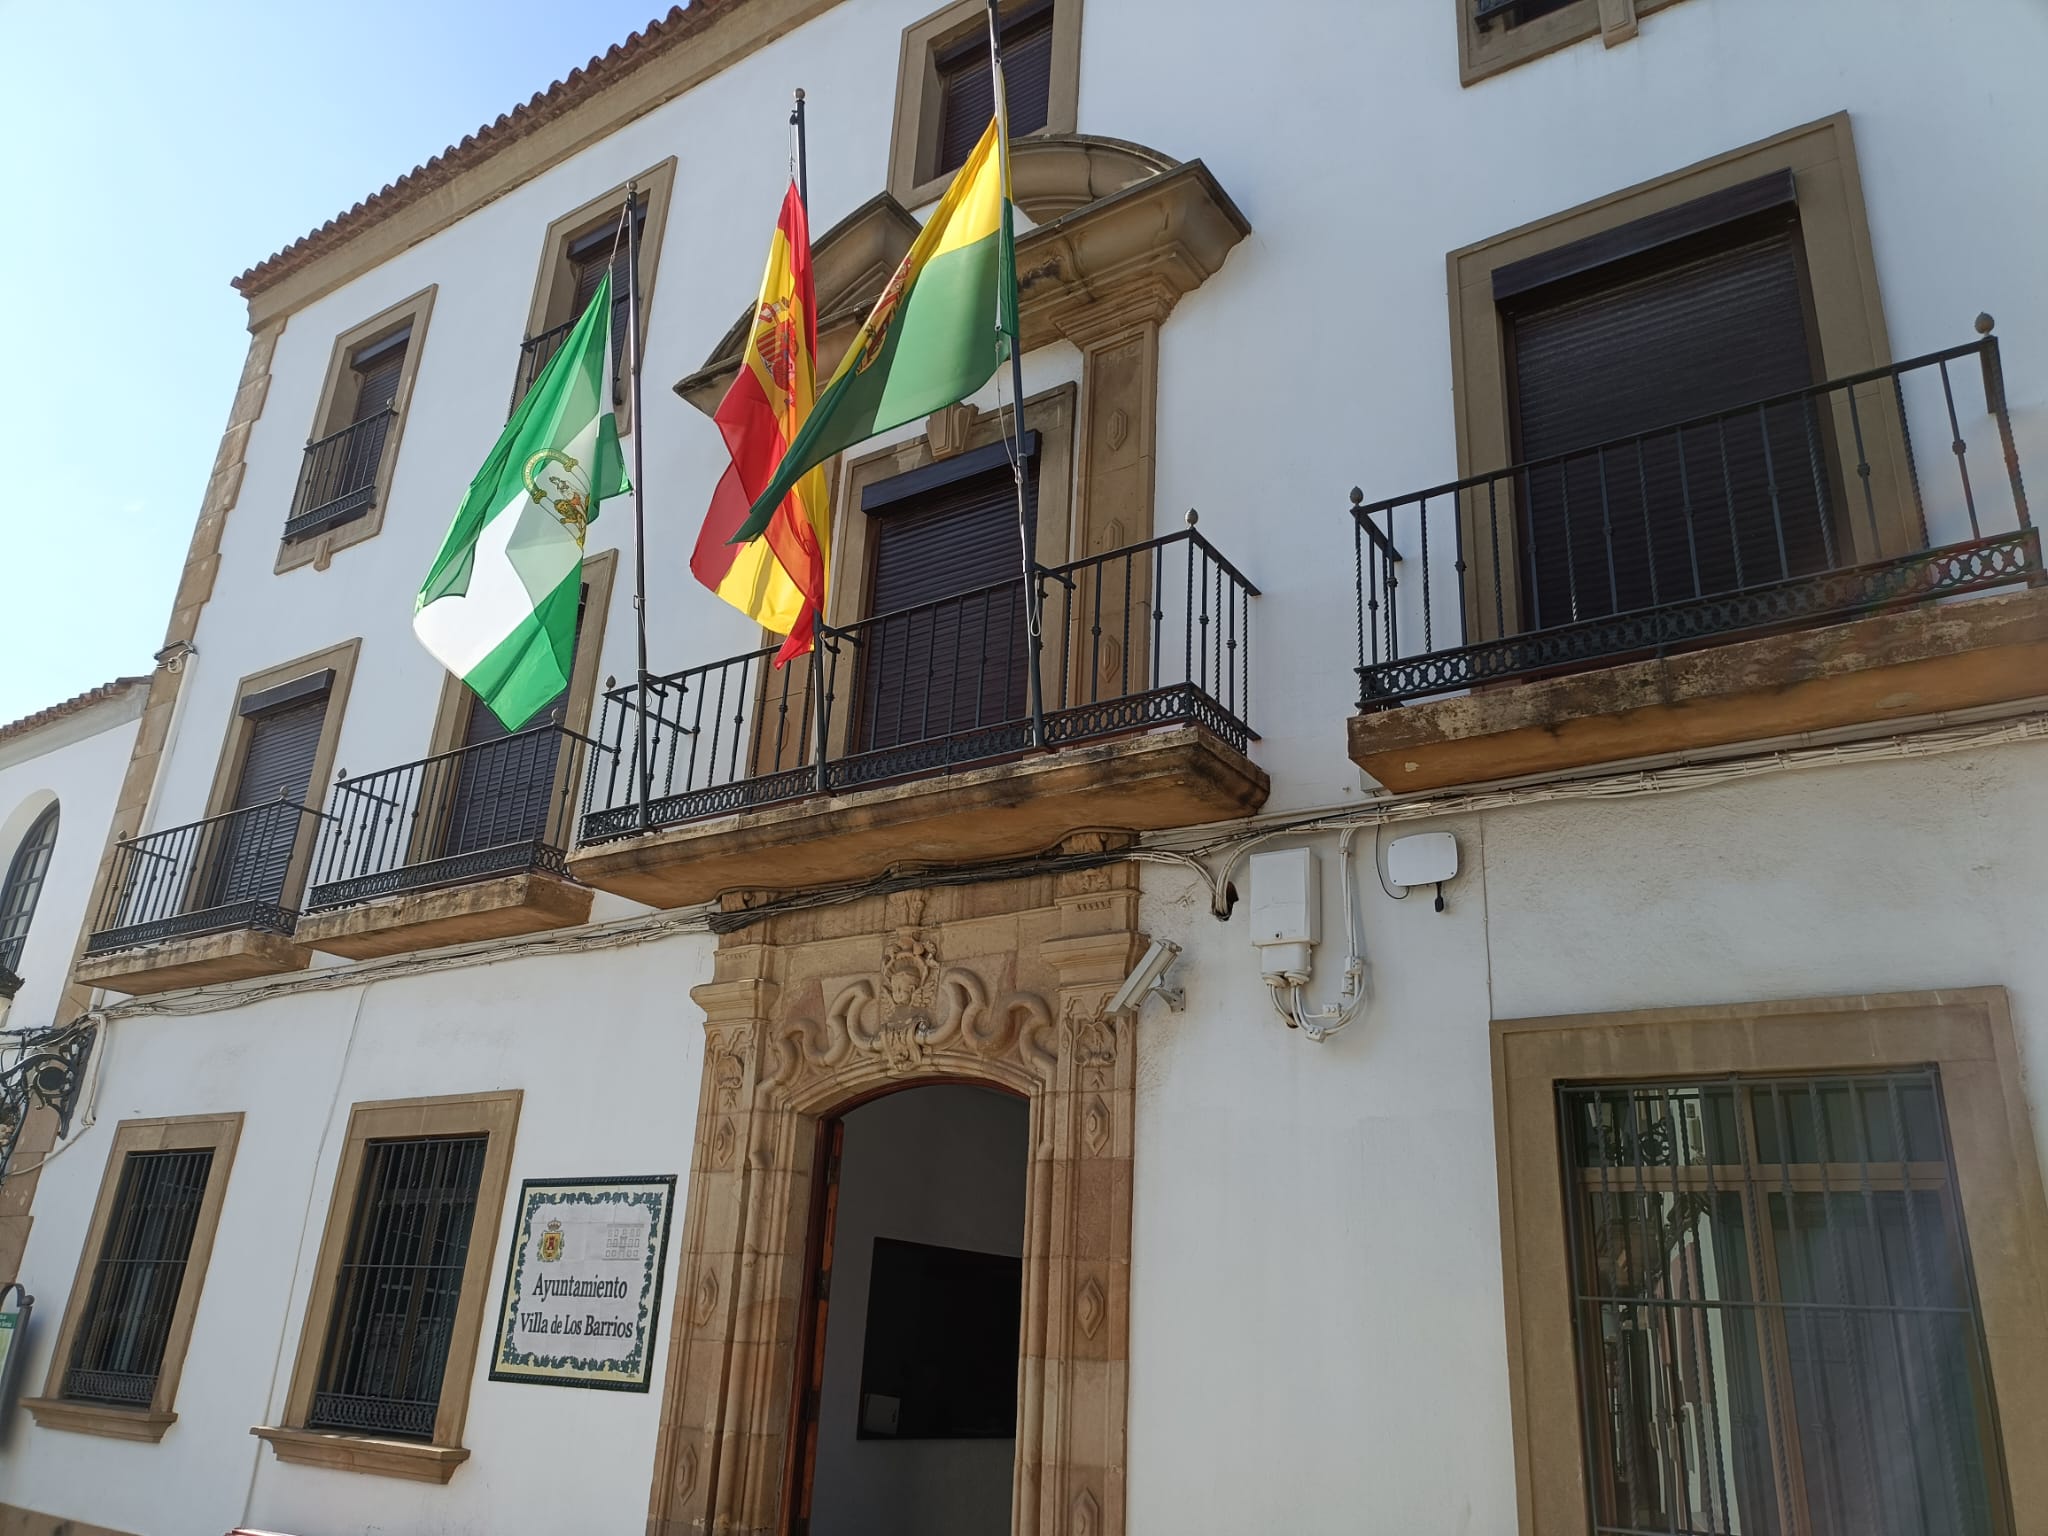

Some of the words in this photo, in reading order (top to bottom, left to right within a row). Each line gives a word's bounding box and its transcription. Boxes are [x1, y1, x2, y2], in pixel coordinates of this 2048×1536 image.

[532, 1272, 628, 1302] Ayuntamiento
[520, 1311, 548, 1334] Villa
[551, 1314, 563, 1334] de
[563, 1314, 582, 1335] Los
[584, 1315, 633, 1338] Barrios
